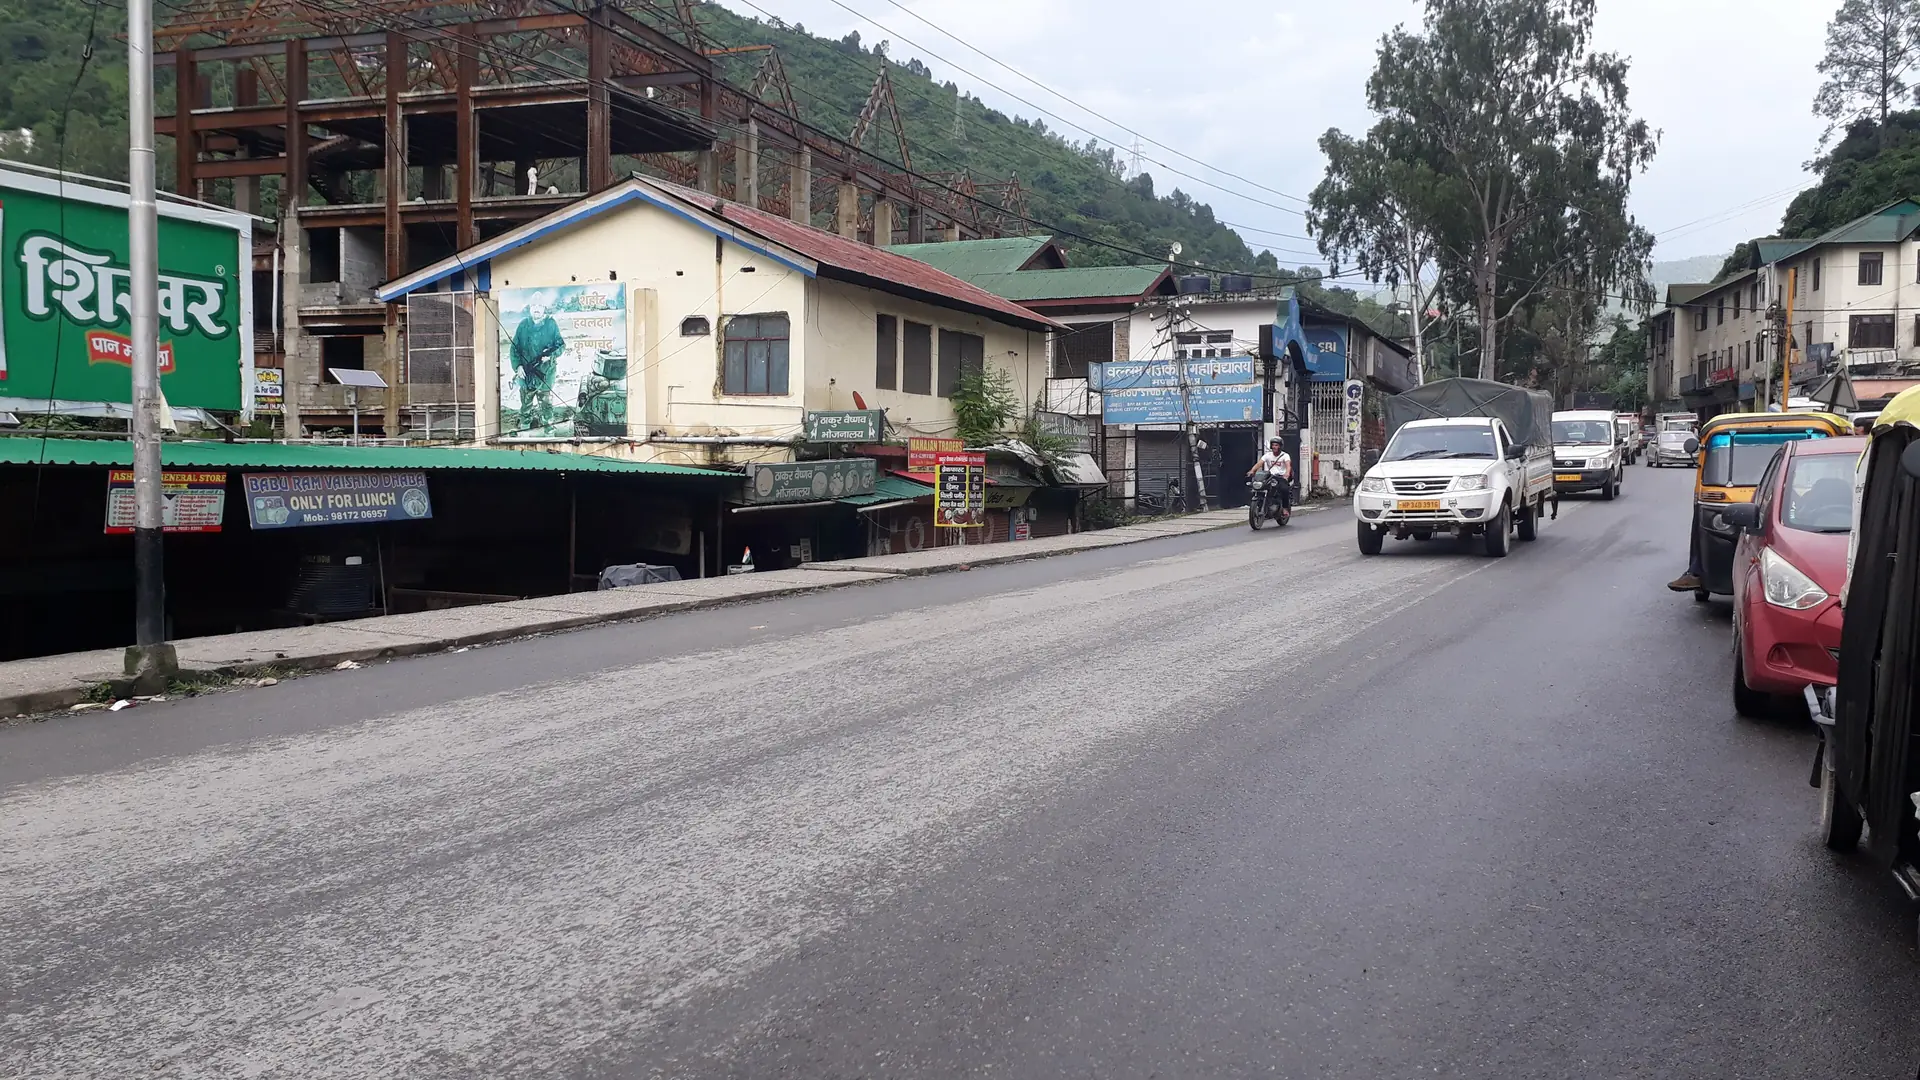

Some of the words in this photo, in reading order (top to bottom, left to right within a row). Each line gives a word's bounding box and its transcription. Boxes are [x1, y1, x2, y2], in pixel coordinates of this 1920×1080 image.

[580, 291, 606, 305] शहीद
[573, 317, 612, 329] हवलदार
[92, 338, 120, 354] पान
[1318, 342, 1336, 352] SBI
[1204, 386, 1224, 394] VGC
[820, 416, 842, 428] ठाकुर
[844, 414, 867, 424] वैष्णव
[822, 429, 864, 438] भोजनालय
[910, 438, 938, 452] MAHAJAN
[938, 440, 963, 452] TRADERS
[199, 474, 226, 483] STORE
[249, 476, 288, 493] BABU
[292, 476, 322, 492] RAM
[322, 474, 380, 490] VAISHNO
[382, 472, 426, 488] DHABA
[774, 470, 794, 486] ठाकुर
[794, 467, 813, 479] वैष्णव
[776, 486, 810, 498] भोजनालय
[290, 495, 323, 510] ONLY
[328, 494, 352, 508] FOR
[356, 492, 396, 508] LUNCH
[304, 512, 329, 522] Mob.:
[331, 511, 359, 521] 98172
[362, 510, 388, 519] 06957
